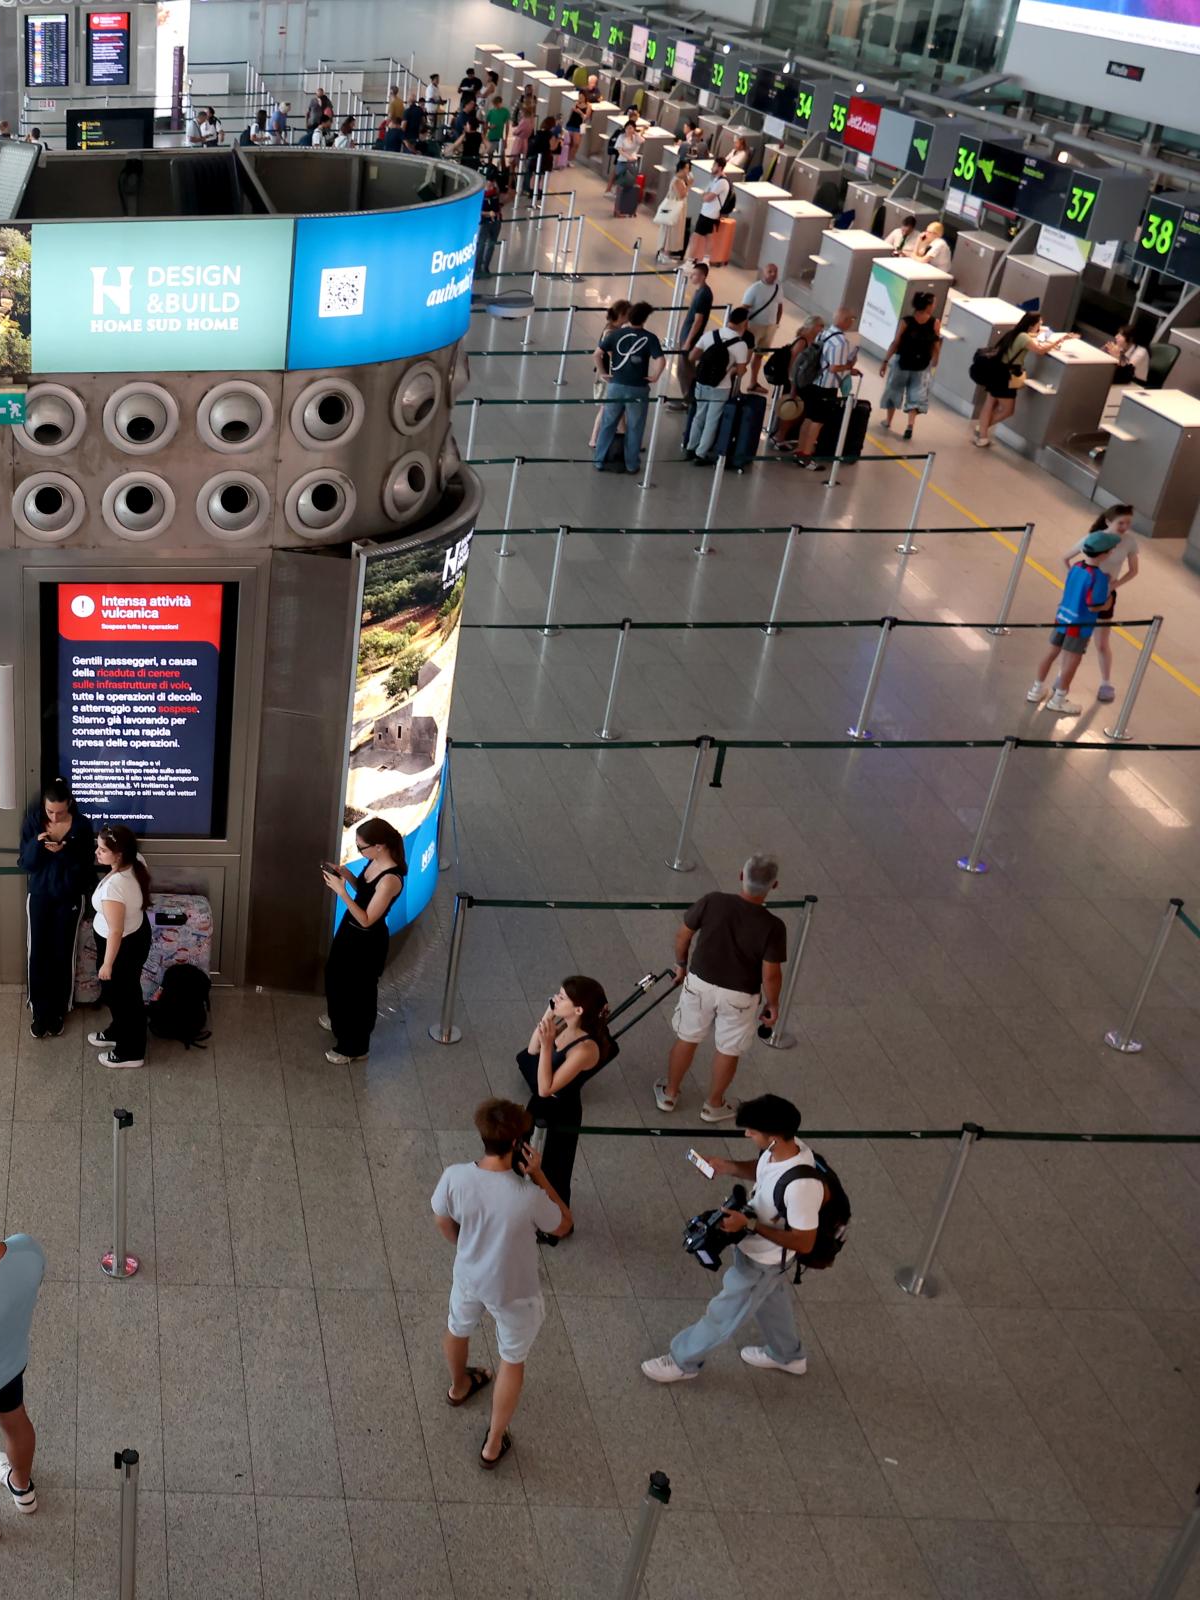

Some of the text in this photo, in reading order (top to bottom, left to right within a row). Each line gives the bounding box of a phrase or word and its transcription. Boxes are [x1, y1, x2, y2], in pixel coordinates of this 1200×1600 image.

[608, 26, 618, 46] 29
[647, 40, 656, 60] 30
[665, 46, 675, 68] 31
[712, 63, 724, 87] 32
[736, 71, 749, 95] 33
[796, 92, 813, 120] 34
[830, 104, 846, 132] 35
[954, 147, 976, 180] 36
[1066, 187, 1095, 223] 37
[1142, 214, 1174, 254] 38
[148, 265, 240, 287] DESIGN
[147, 292, 240, 314] &BUILD
[91, 317, 239, 332] HOME SUD HOME
[102, 596, 191, 607] Intensa attività
[102, 608, 159, 618] vulcanica
[72, 656, 102, 665] Gentili
[104, 657, 158, 667] passeggeri,
[72, 669, 95, 677] della
[97, 669, 135, 677] ricaduta
[137, 669, 146, 677] di
[72, 680, 192, 690] sulle infrastrutture di volo,
[72, 692, 202, 703] tutte le operazioni di decollo
[80, 704, 131, 714] atterraggio
[159, 706, 199, 715] sospese.
[72, 716, 187, 726] Stiamo già lavorando per
[72, 727, 120, 736] consentire
[142, 728, 171, 737] rapida
[72, 739, 180, 749] ripresa delle operazioni.
